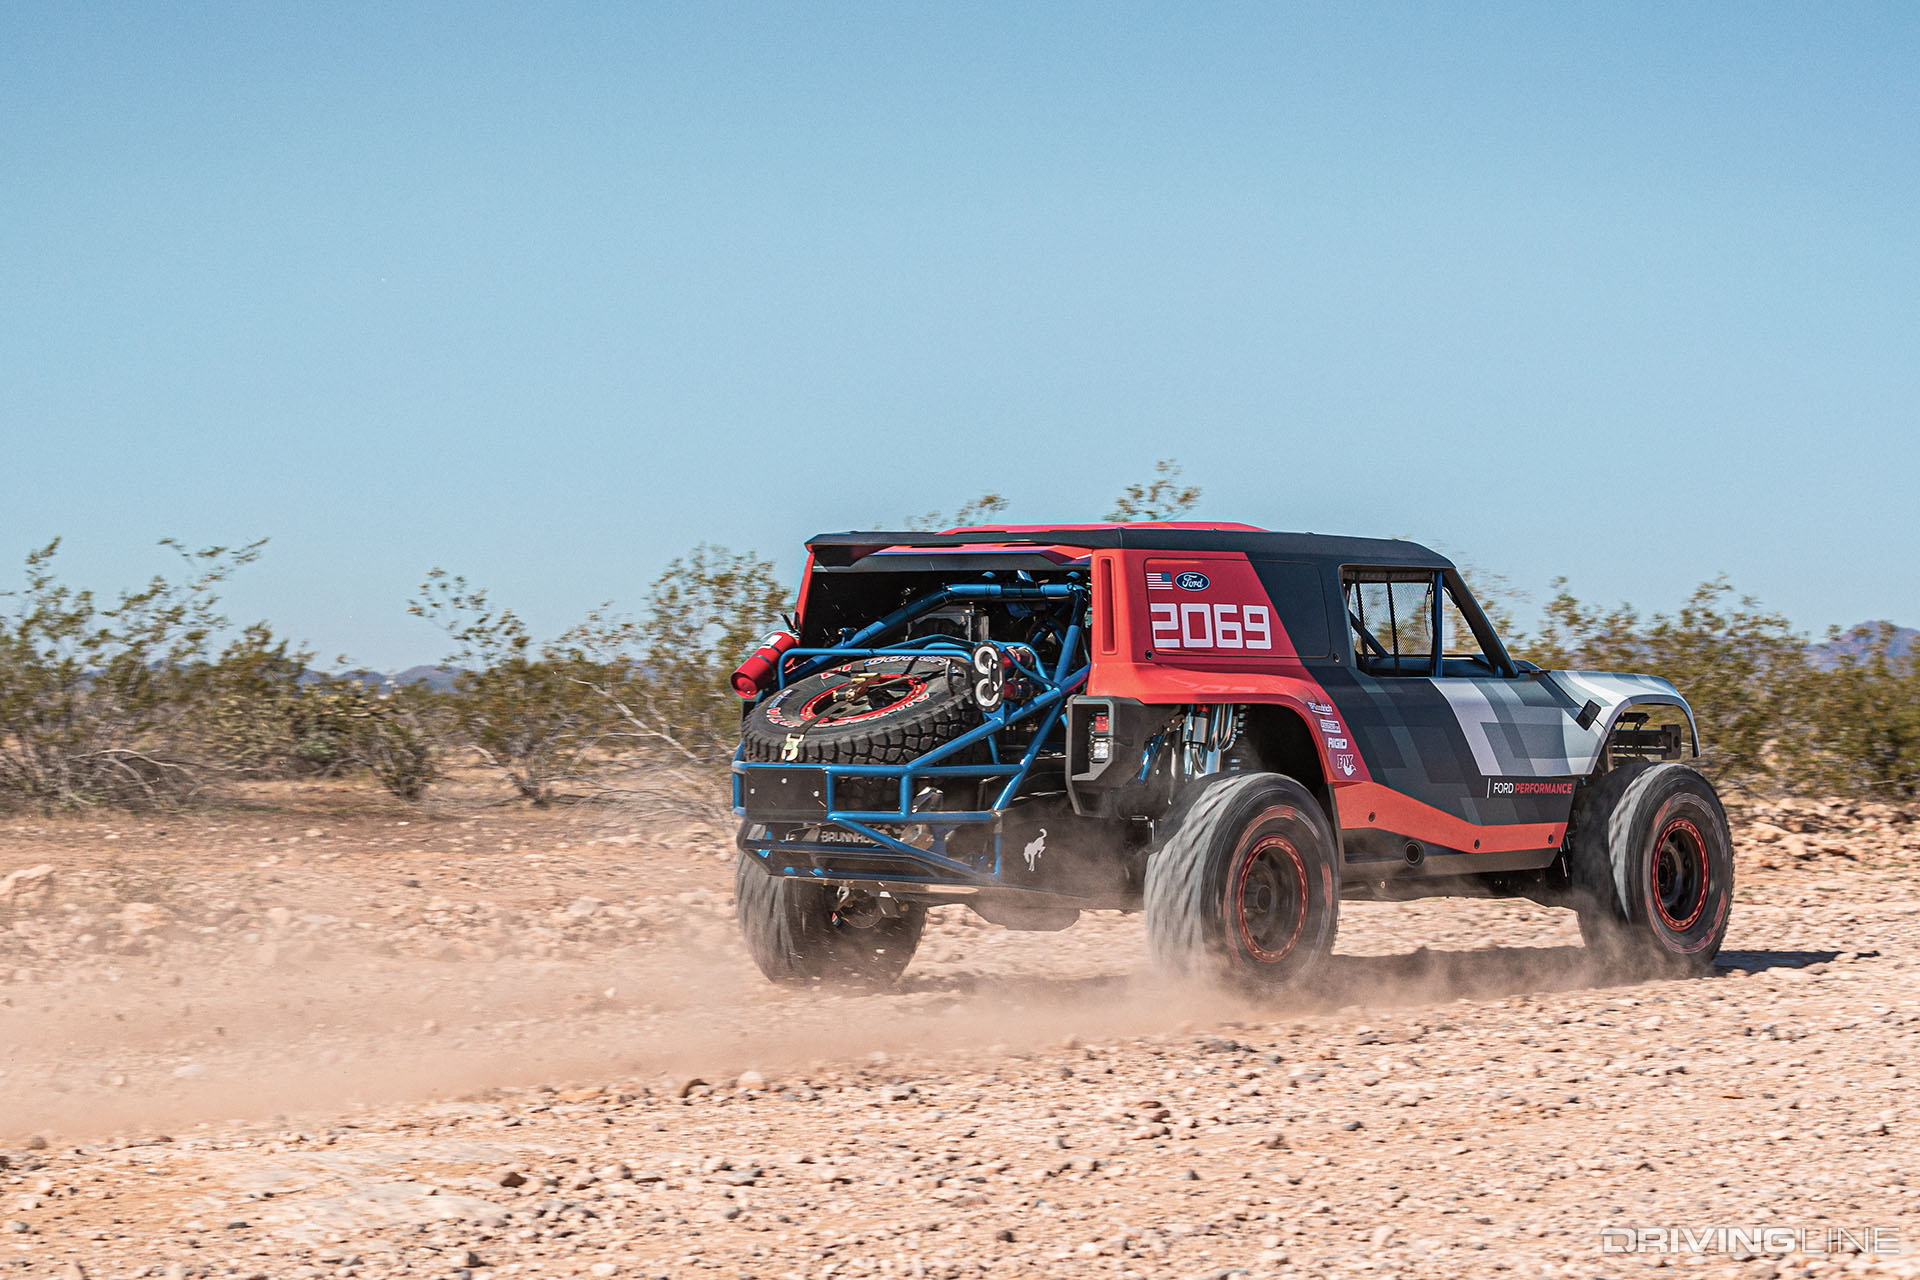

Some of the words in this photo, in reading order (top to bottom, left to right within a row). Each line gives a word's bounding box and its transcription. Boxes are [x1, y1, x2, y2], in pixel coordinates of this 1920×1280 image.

[1182, 574, 1203, 588] Ford
[1150, 603, 1272, 649] 2069
[1337, 754, 1354, 769] FOX
[1493, 782, 1514, 794] FORD
[1514, 783, 1573, 794] PERFORMANCE
